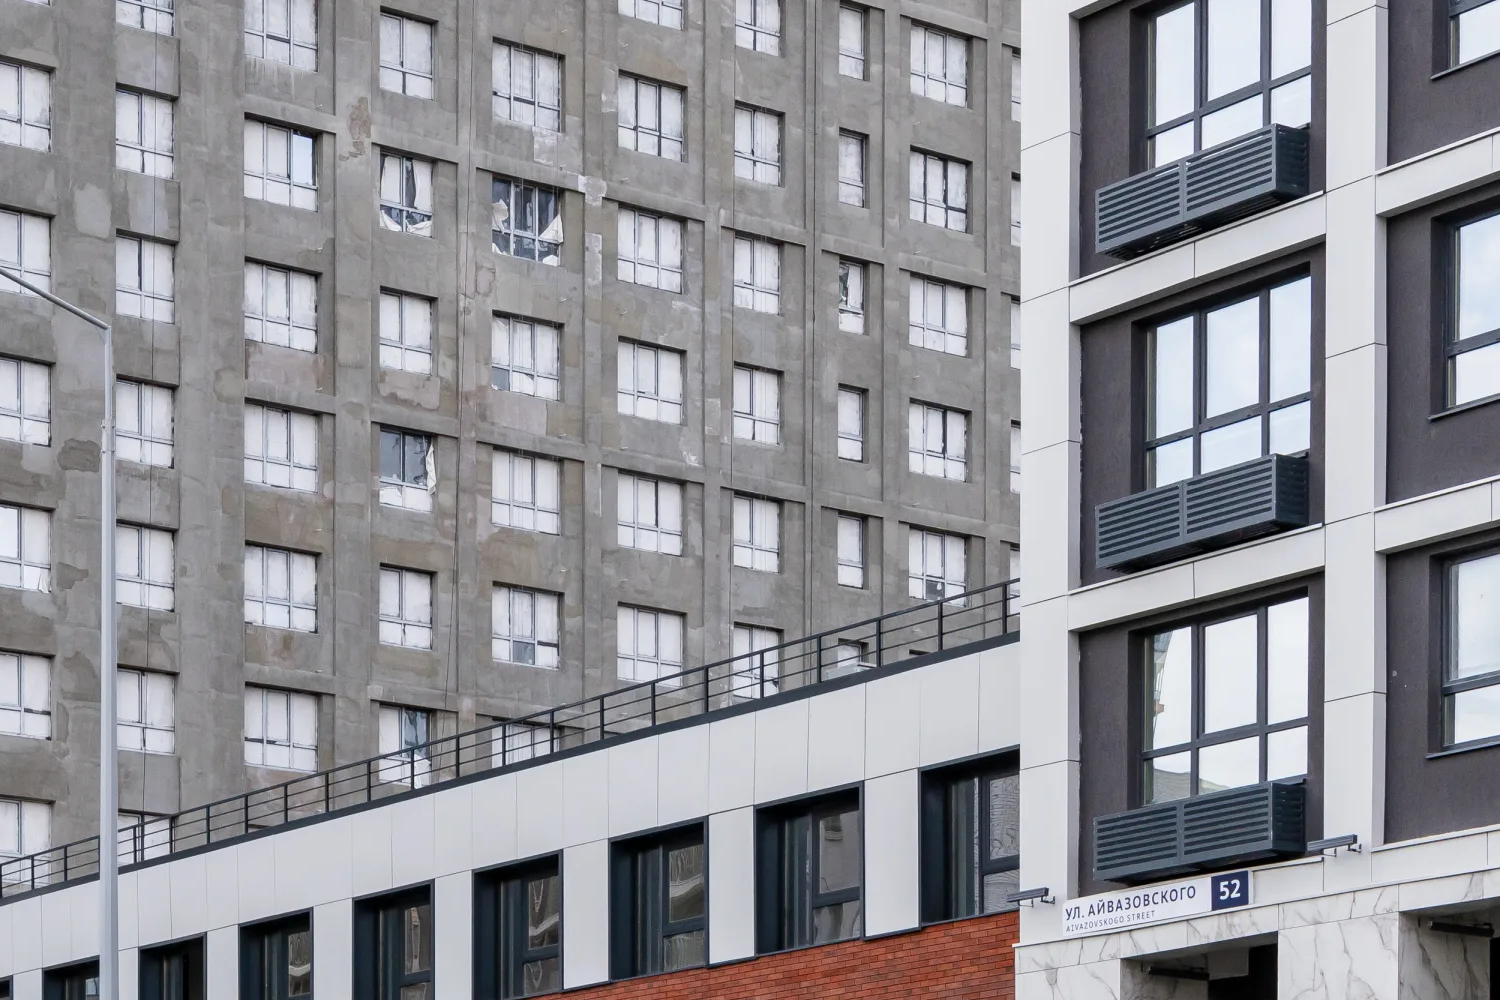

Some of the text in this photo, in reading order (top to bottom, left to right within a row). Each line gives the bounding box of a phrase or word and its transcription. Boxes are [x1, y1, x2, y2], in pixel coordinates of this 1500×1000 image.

[1219, 879, 1241, 900] 52
[1065, 885, 1196, 920] УЛ. АЙВАЗОВСКОГО
[1066, 910, 1155, 932] AIVAZOVSKOGO STREET
